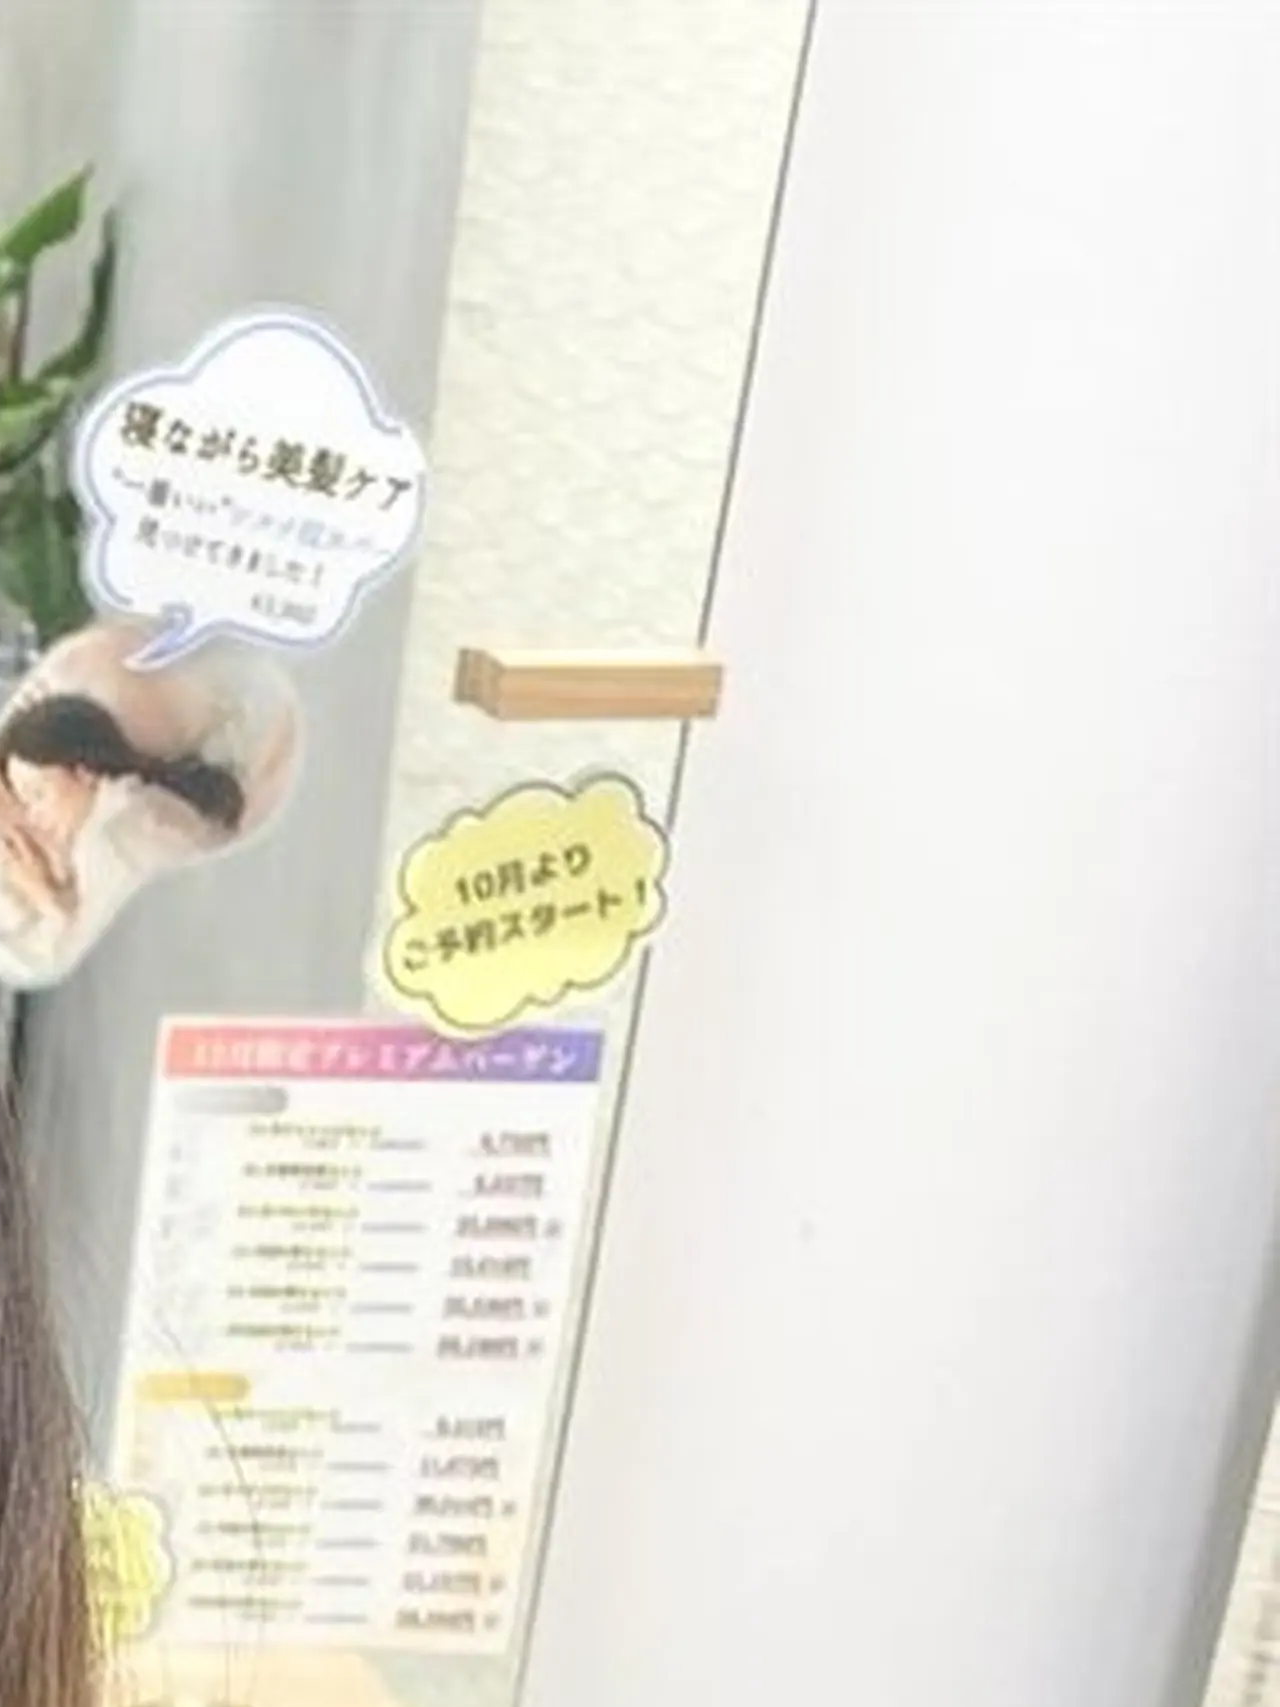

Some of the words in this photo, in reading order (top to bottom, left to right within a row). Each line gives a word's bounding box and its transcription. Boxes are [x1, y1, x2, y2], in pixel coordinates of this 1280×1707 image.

[121, 402, 413, 511] 寝ながら美髪ケア
[452, 843, 594, 906] 10月より
[401, 878, 648, 975] ご予約スタート！
